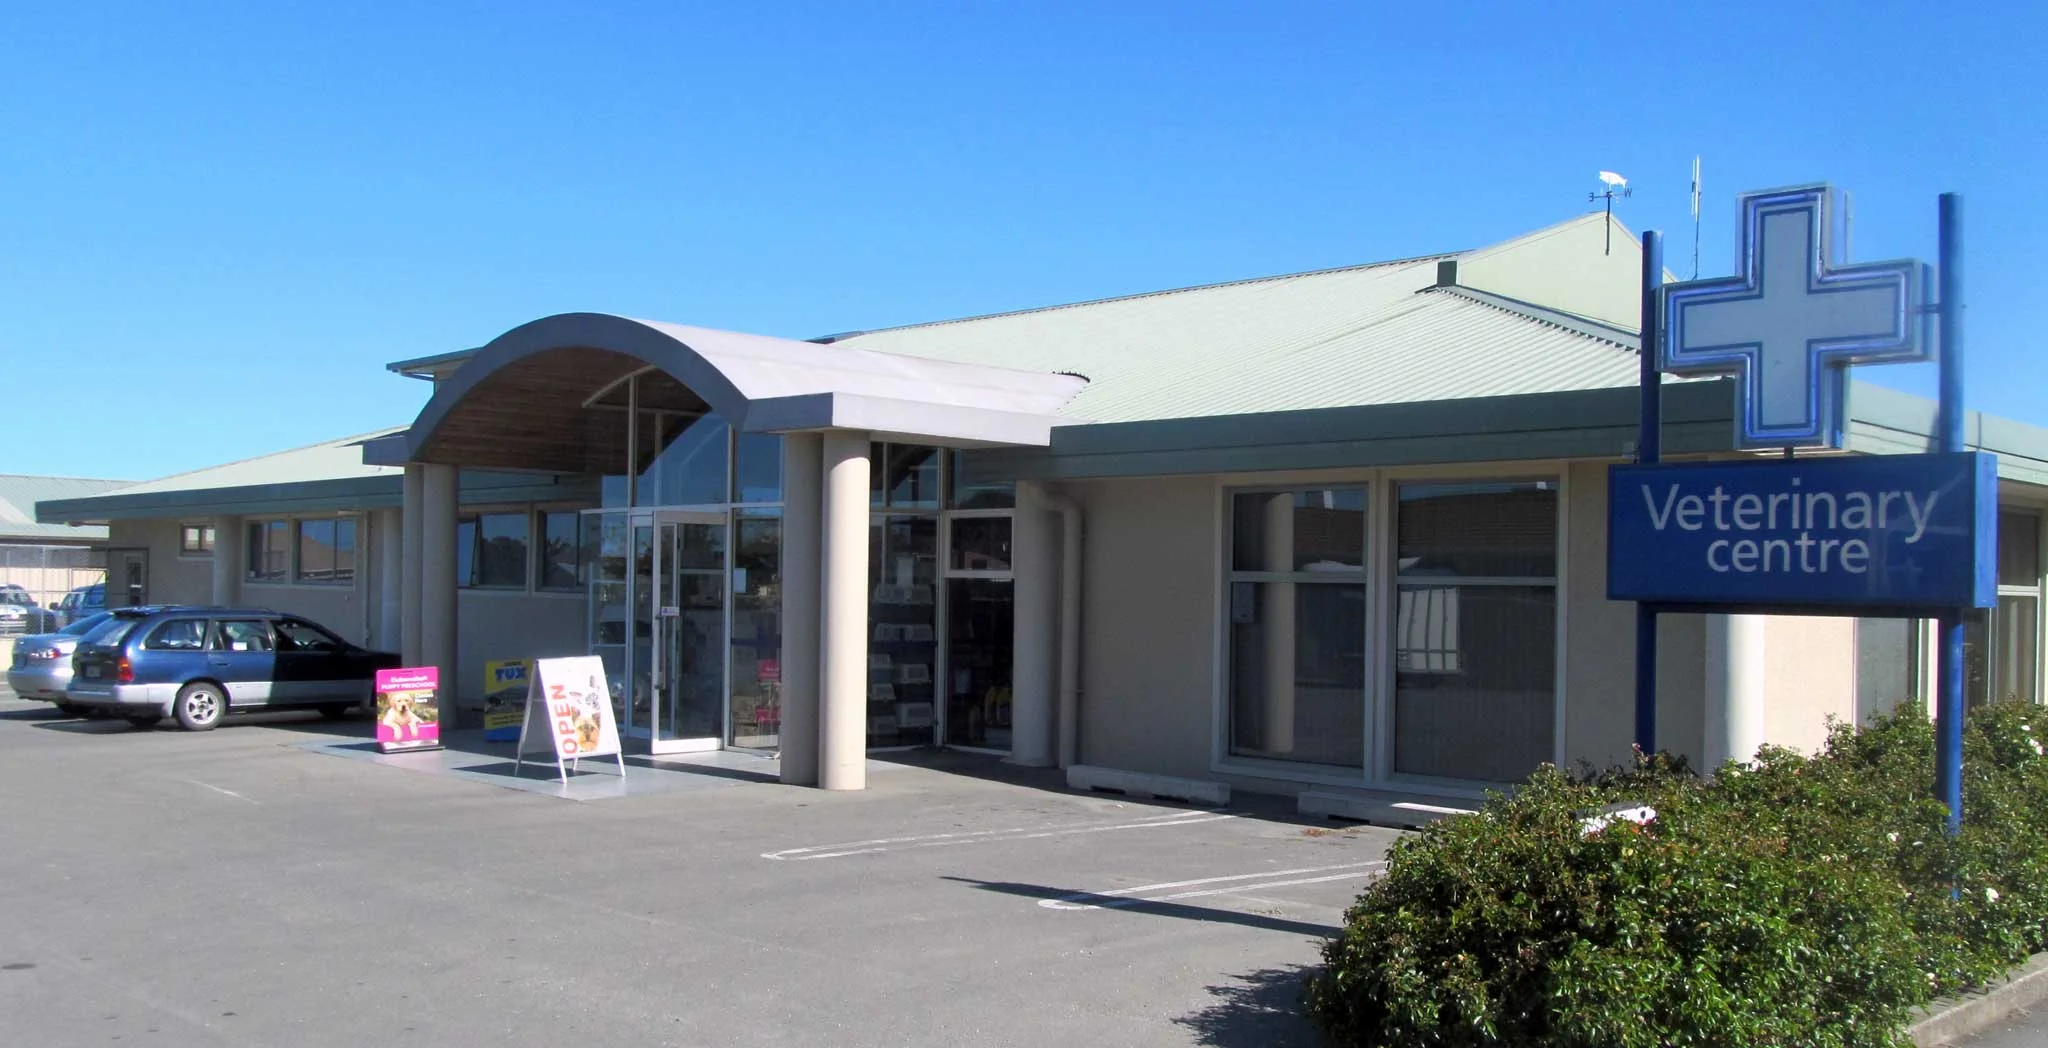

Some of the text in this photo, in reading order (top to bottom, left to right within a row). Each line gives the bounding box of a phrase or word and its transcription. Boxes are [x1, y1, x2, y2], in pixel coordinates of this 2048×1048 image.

[1641, 477, 1939, 544] Veterinary
[1707, 532, 1870, 574] centre
[495, 667, 528, 682] TUX
[550, 684, 578, 754] OPEN
